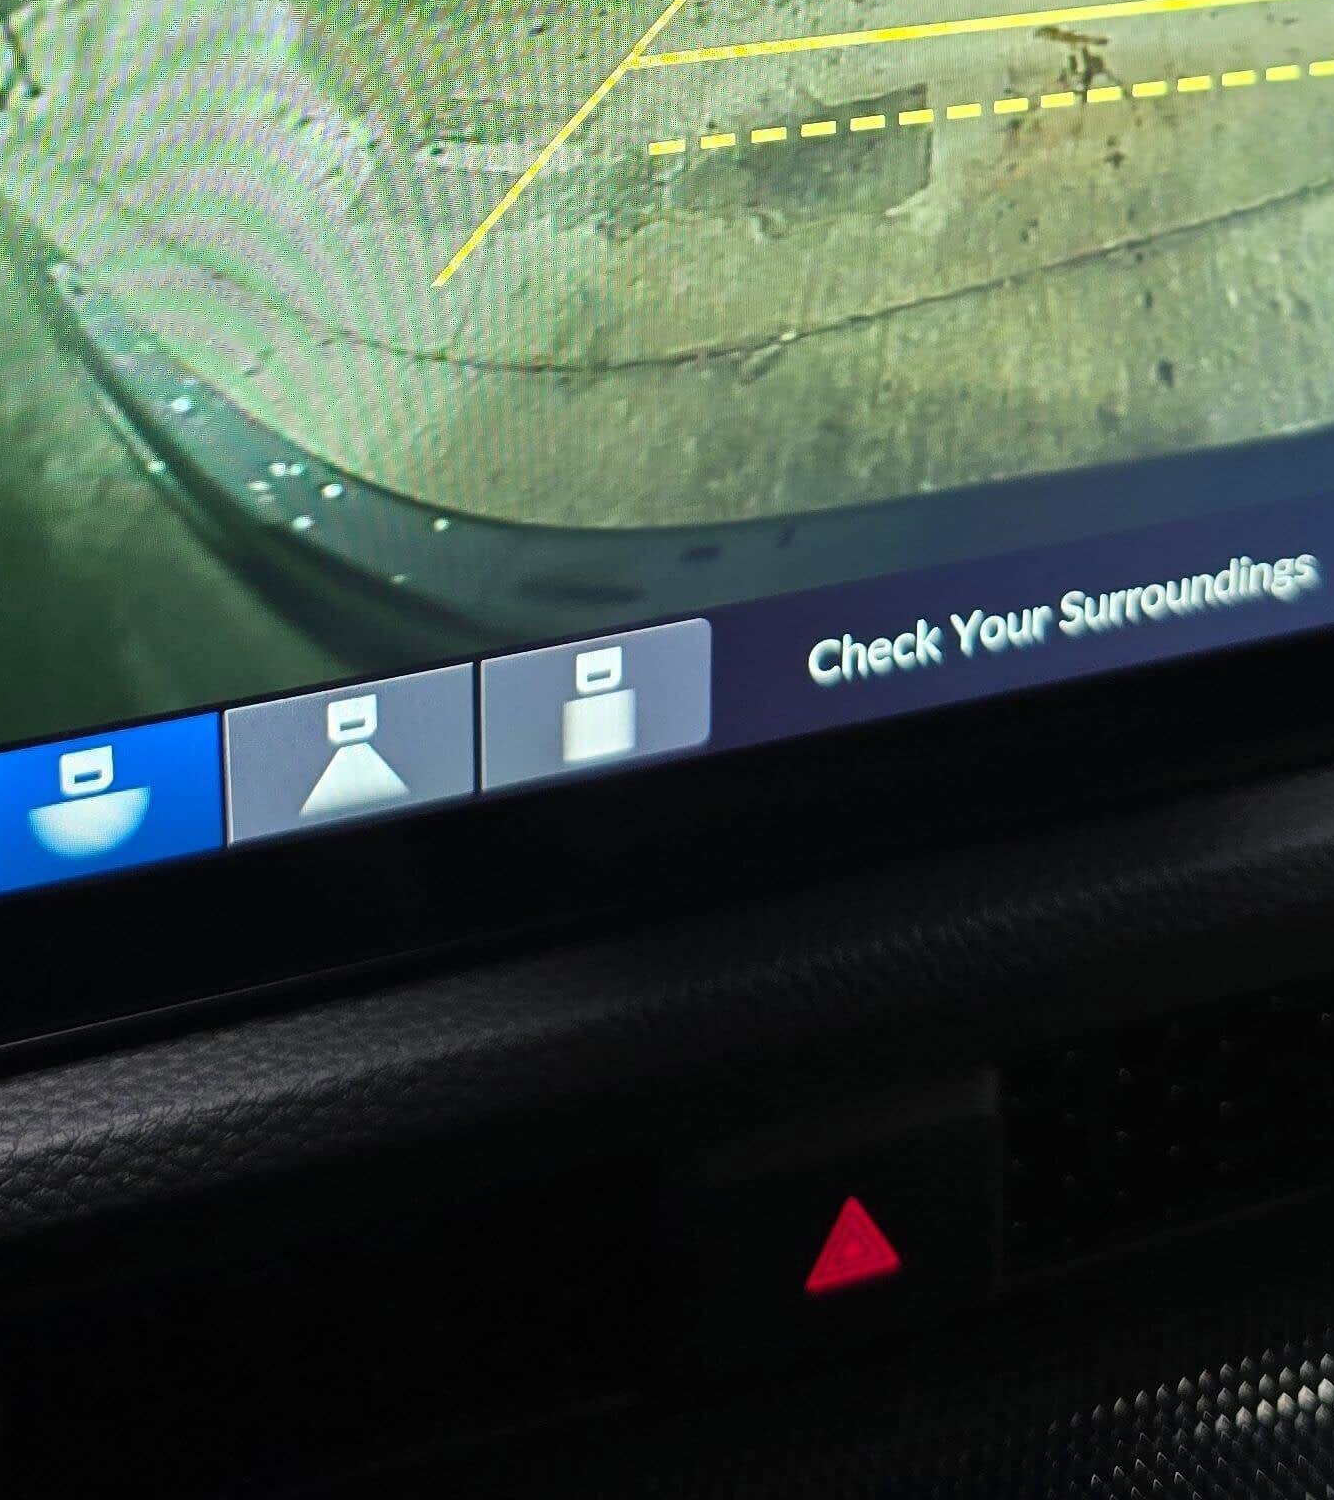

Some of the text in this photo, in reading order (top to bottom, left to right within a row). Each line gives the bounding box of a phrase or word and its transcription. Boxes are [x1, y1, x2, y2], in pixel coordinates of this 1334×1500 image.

[808, 553, 1322, 686] Check Your Surroundings
